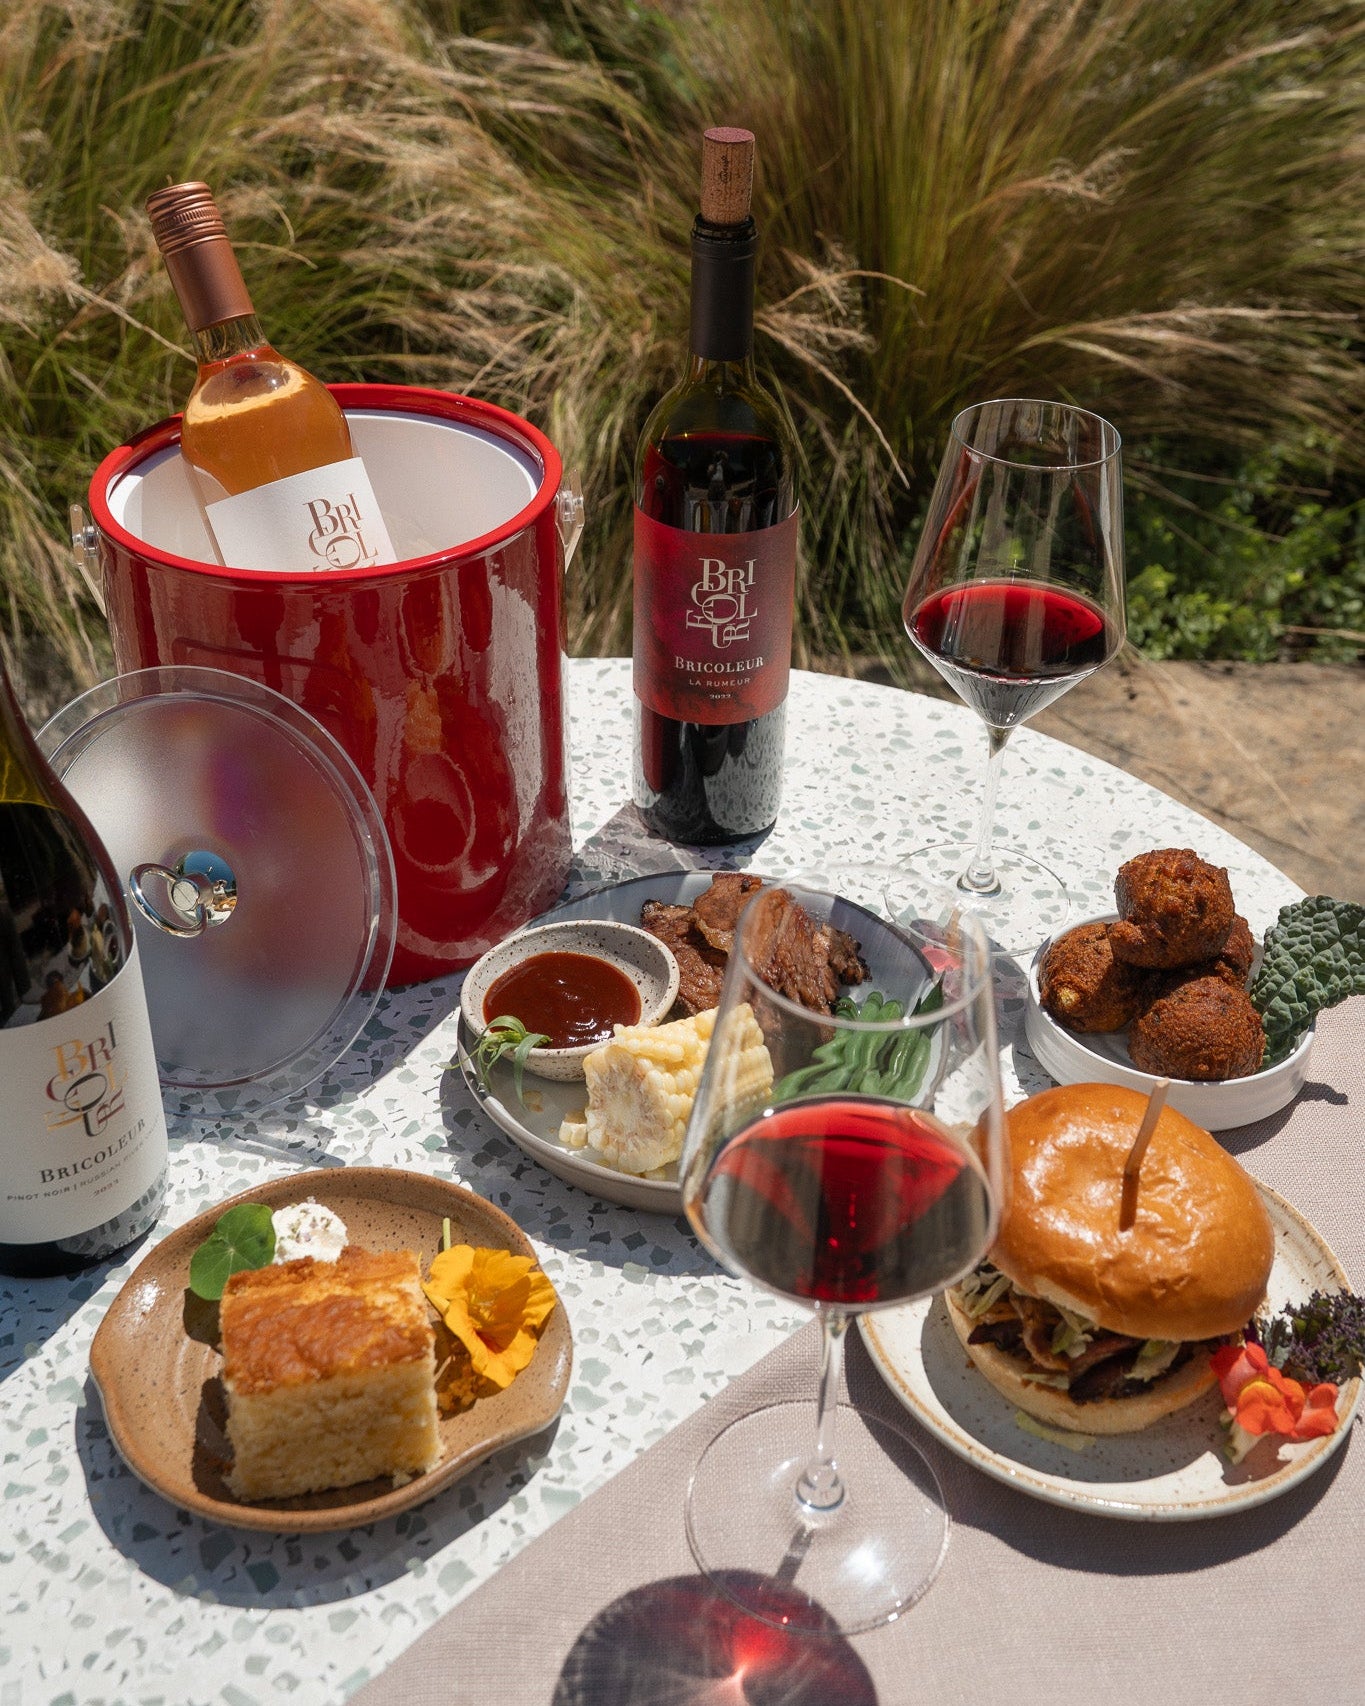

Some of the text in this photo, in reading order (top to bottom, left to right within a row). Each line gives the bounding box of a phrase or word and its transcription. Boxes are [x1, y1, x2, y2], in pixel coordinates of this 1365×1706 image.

[675, 656, 764, 673] BRICOLEUR
[706, 678, 751, 687] RUMEUR
[40, 1118, 146, 1184] BRICOLEUR
[7, 1193, 40, 1201] PINOT
[44, 1186, 71, 1198] NOIR
